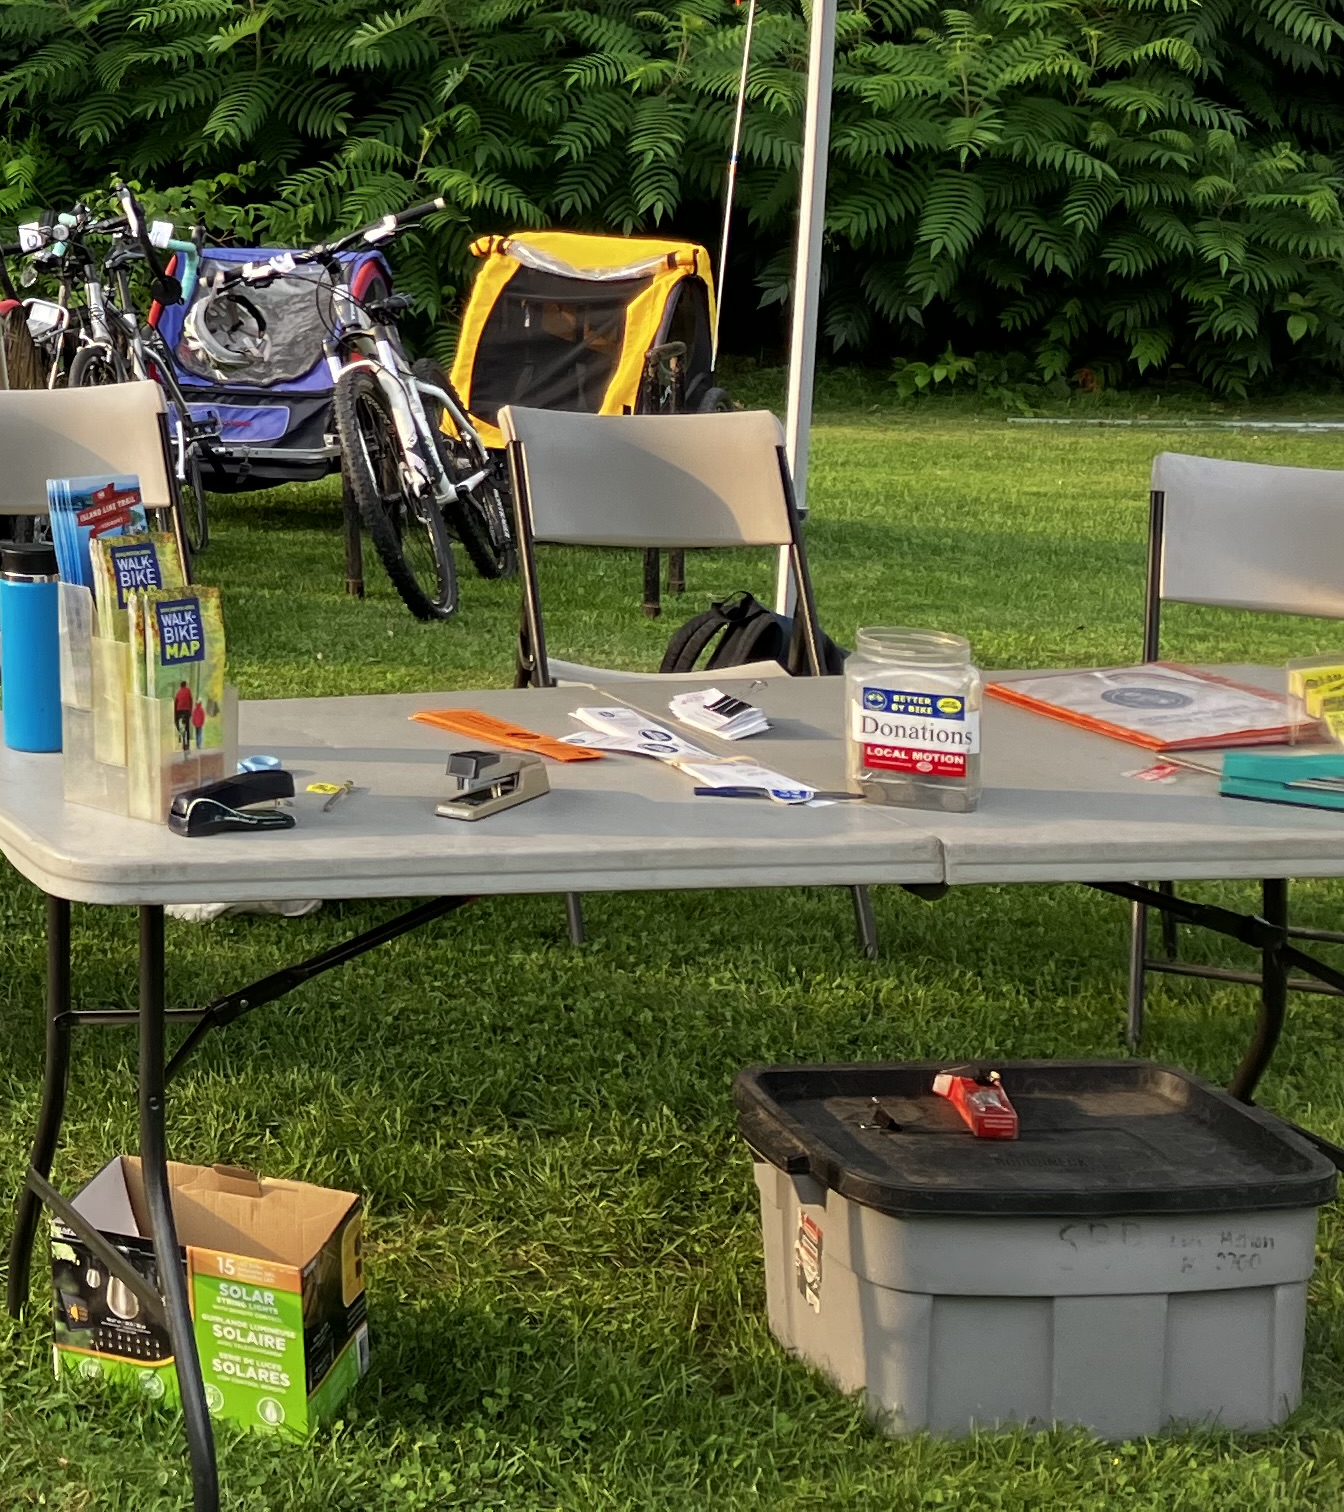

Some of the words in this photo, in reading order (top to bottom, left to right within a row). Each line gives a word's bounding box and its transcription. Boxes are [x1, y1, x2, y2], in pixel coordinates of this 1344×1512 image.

[120, 568, 157, 587] BIKE
[164, 623, 200, 644] BIKE
[165, 641, 201, 660] MAP
[891, 703, 905, 711] BY
[908, 705, 933, 714] BIKE
[893, 694, 931, 705] BETTER
[862, 715, 973, 745] Donations
[866, 746, 909, 759] LOCAL
[912, 751, 964, 764] MOTION
[216, 1256, 236, 1276] 15
[218, 1283, 275, 1306] SOLAR
[216, 1296, 247, 1309] STRING
[248, 1303, 279, 1315] LIGHTS
[212, 1324, 286, 1351] SOLAIRE
[212, 1358, 291, 1387] SOLARES
